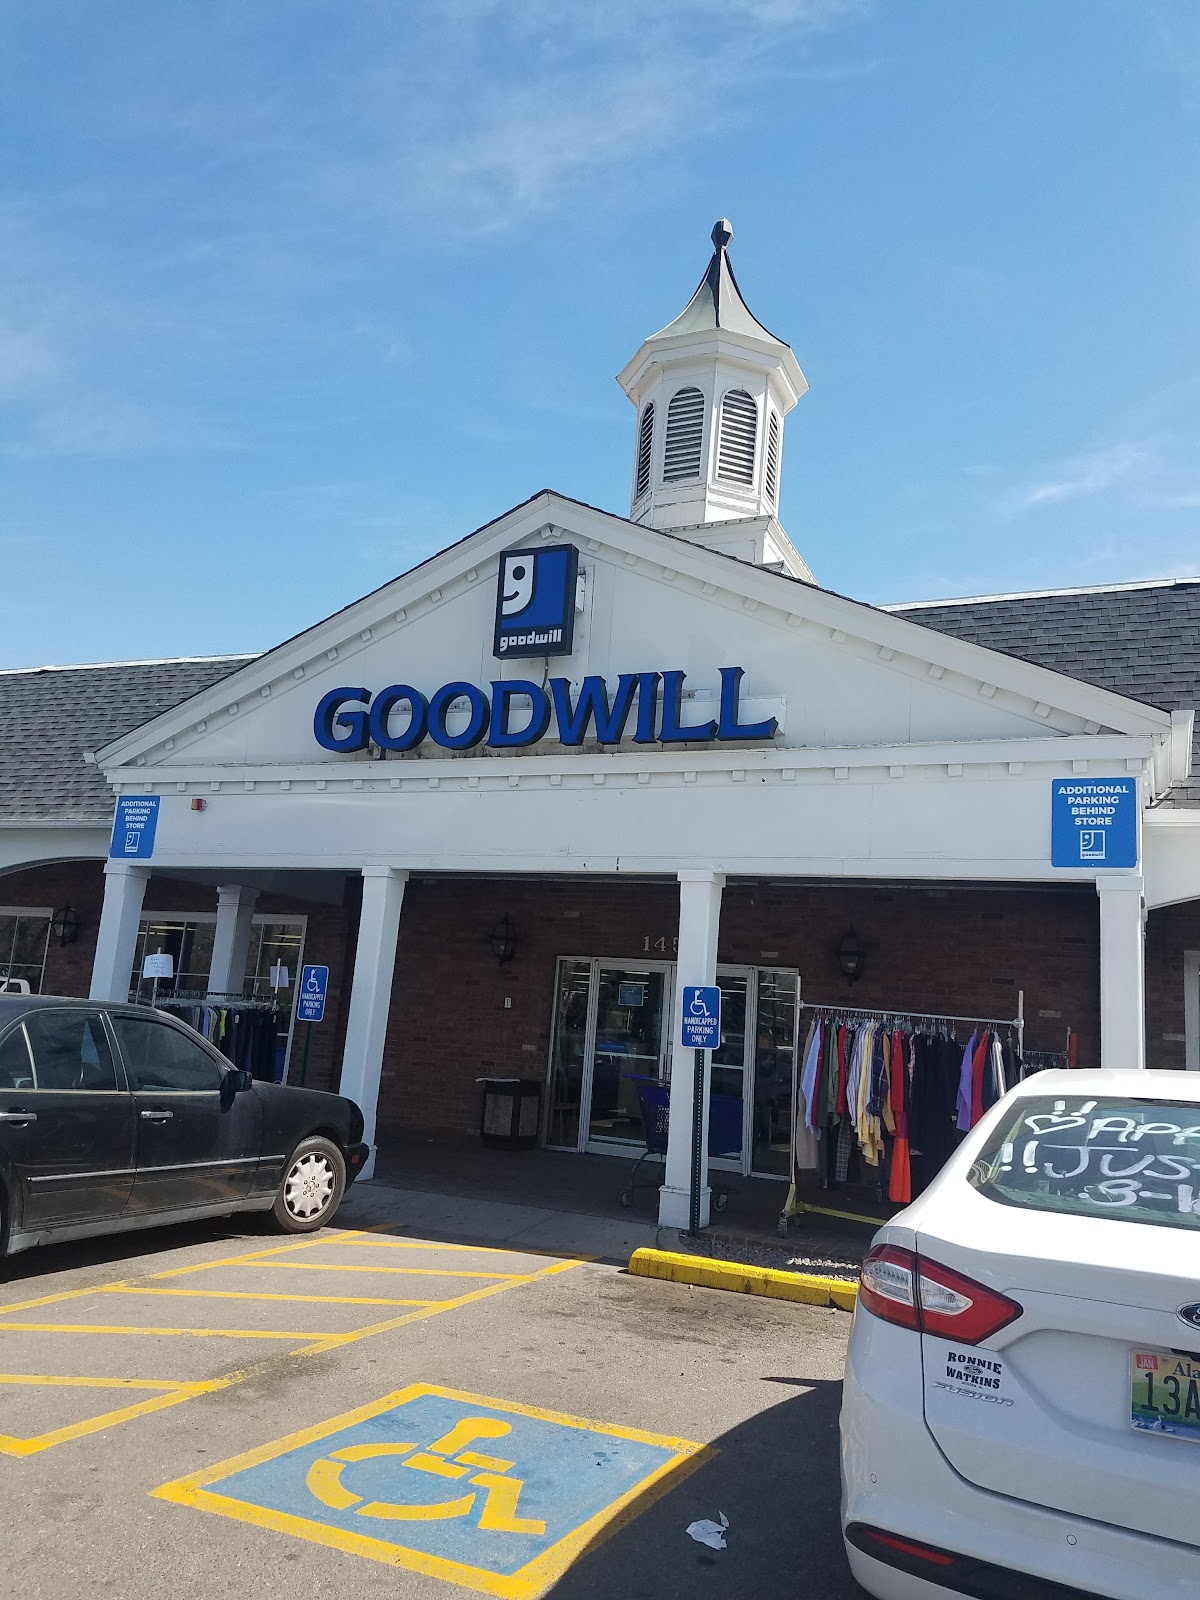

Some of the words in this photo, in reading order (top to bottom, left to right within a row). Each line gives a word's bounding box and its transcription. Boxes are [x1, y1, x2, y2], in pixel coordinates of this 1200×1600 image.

[500, 629, 562, 652] goodwill
[313, 666, 778, 753] GOODWILL
[1058, 785, 1129, 794] ADDITIONAL
[1068, 796, 1119, 804] PARKING
[1072, 807, 1115, 815] BEHIND
[1074, 817, 1112, 825] STORE
[684, 1017, 717, 1025] HANDICAPPED
[687, 1026, 713, 1034] PARKING
[1043, 1144, 1200, 1180] JUS
[947, 1352, 1002, 1375] RONNIE
[1138, 1358, 1154, 1369] JAN
[946, 1366, 1001, 1389] WATKINS
